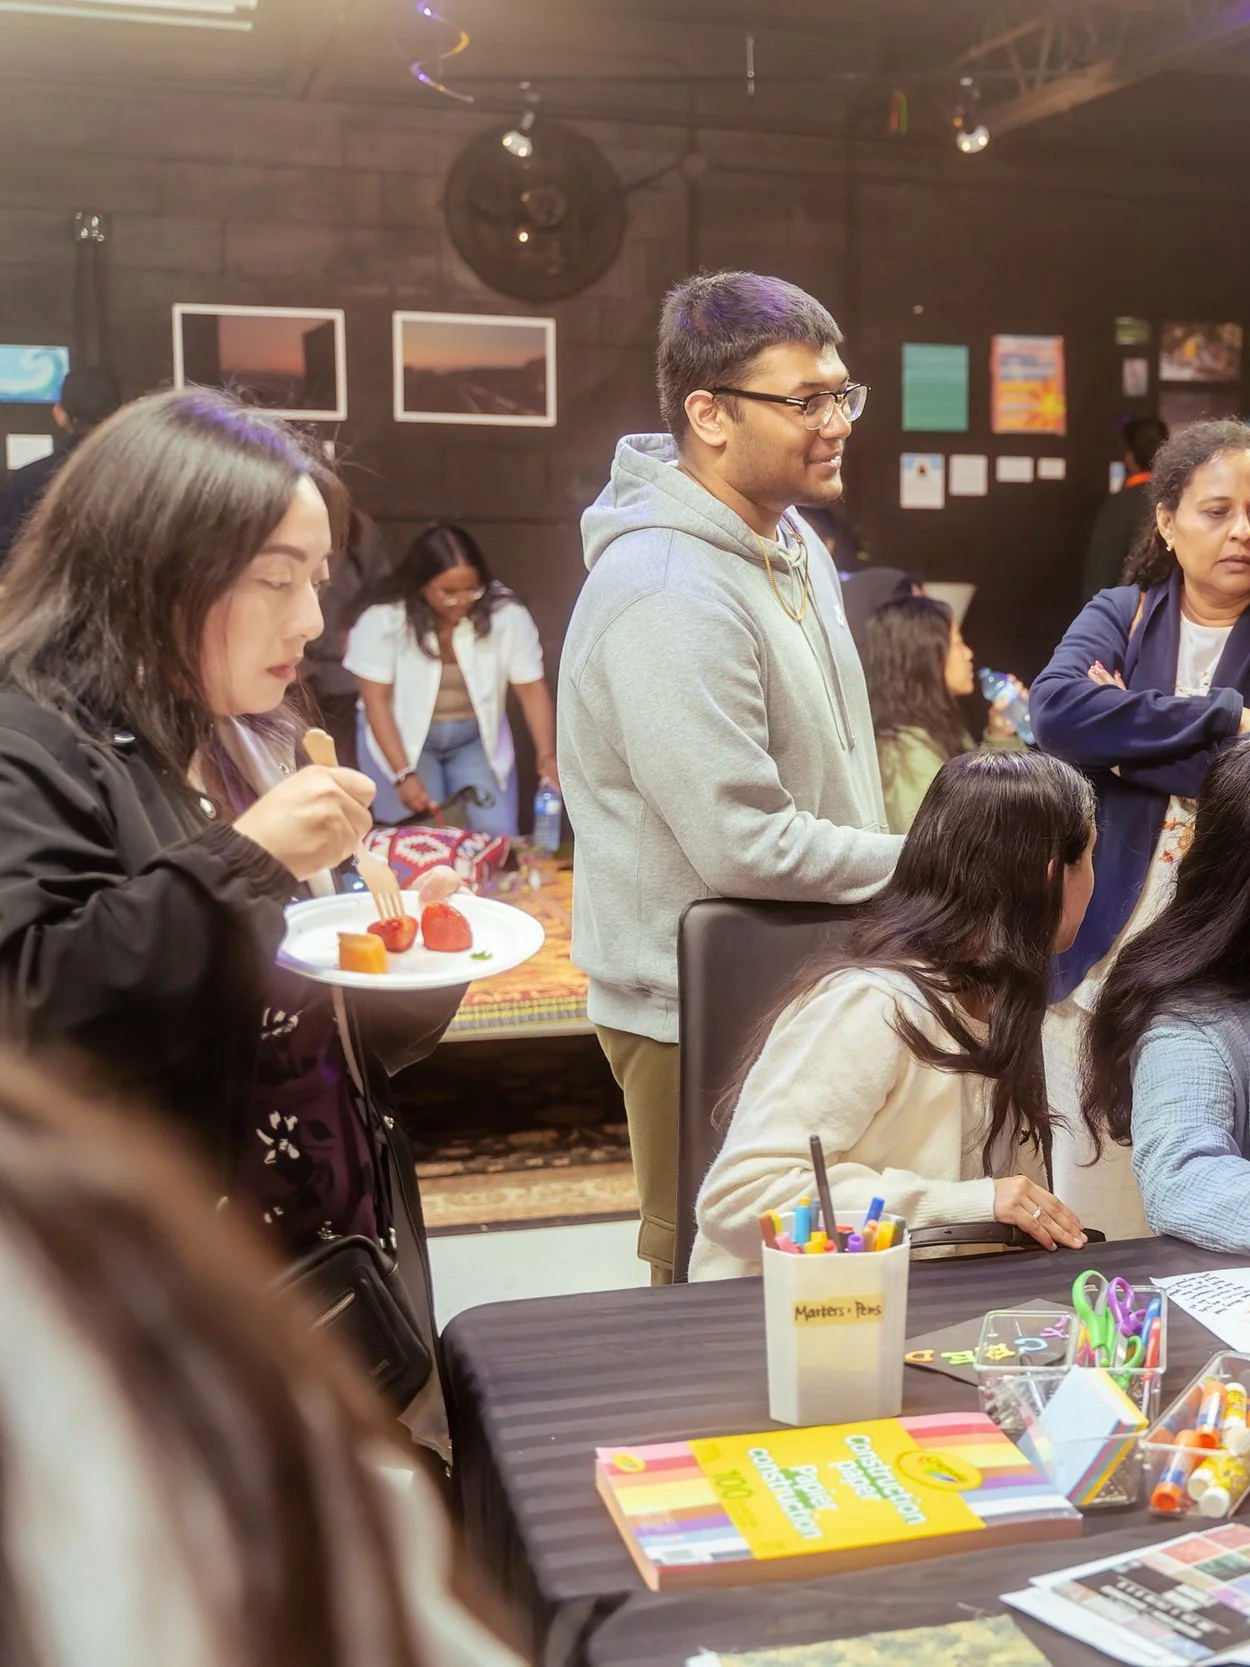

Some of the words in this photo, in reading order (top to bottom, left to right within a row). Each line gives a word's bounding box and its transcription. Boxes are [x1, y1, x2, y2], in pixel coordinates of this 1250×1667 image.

[855, 1300, 882, 1319] Pens
[713, 1468, 754, 1501] 100
[745, 1447, 823, 1541] construction
[787, 1464, 839, 1511] Papier
[827, 1459, 884, 1501] paper
[844, 1434, 928, 1525] Construction
